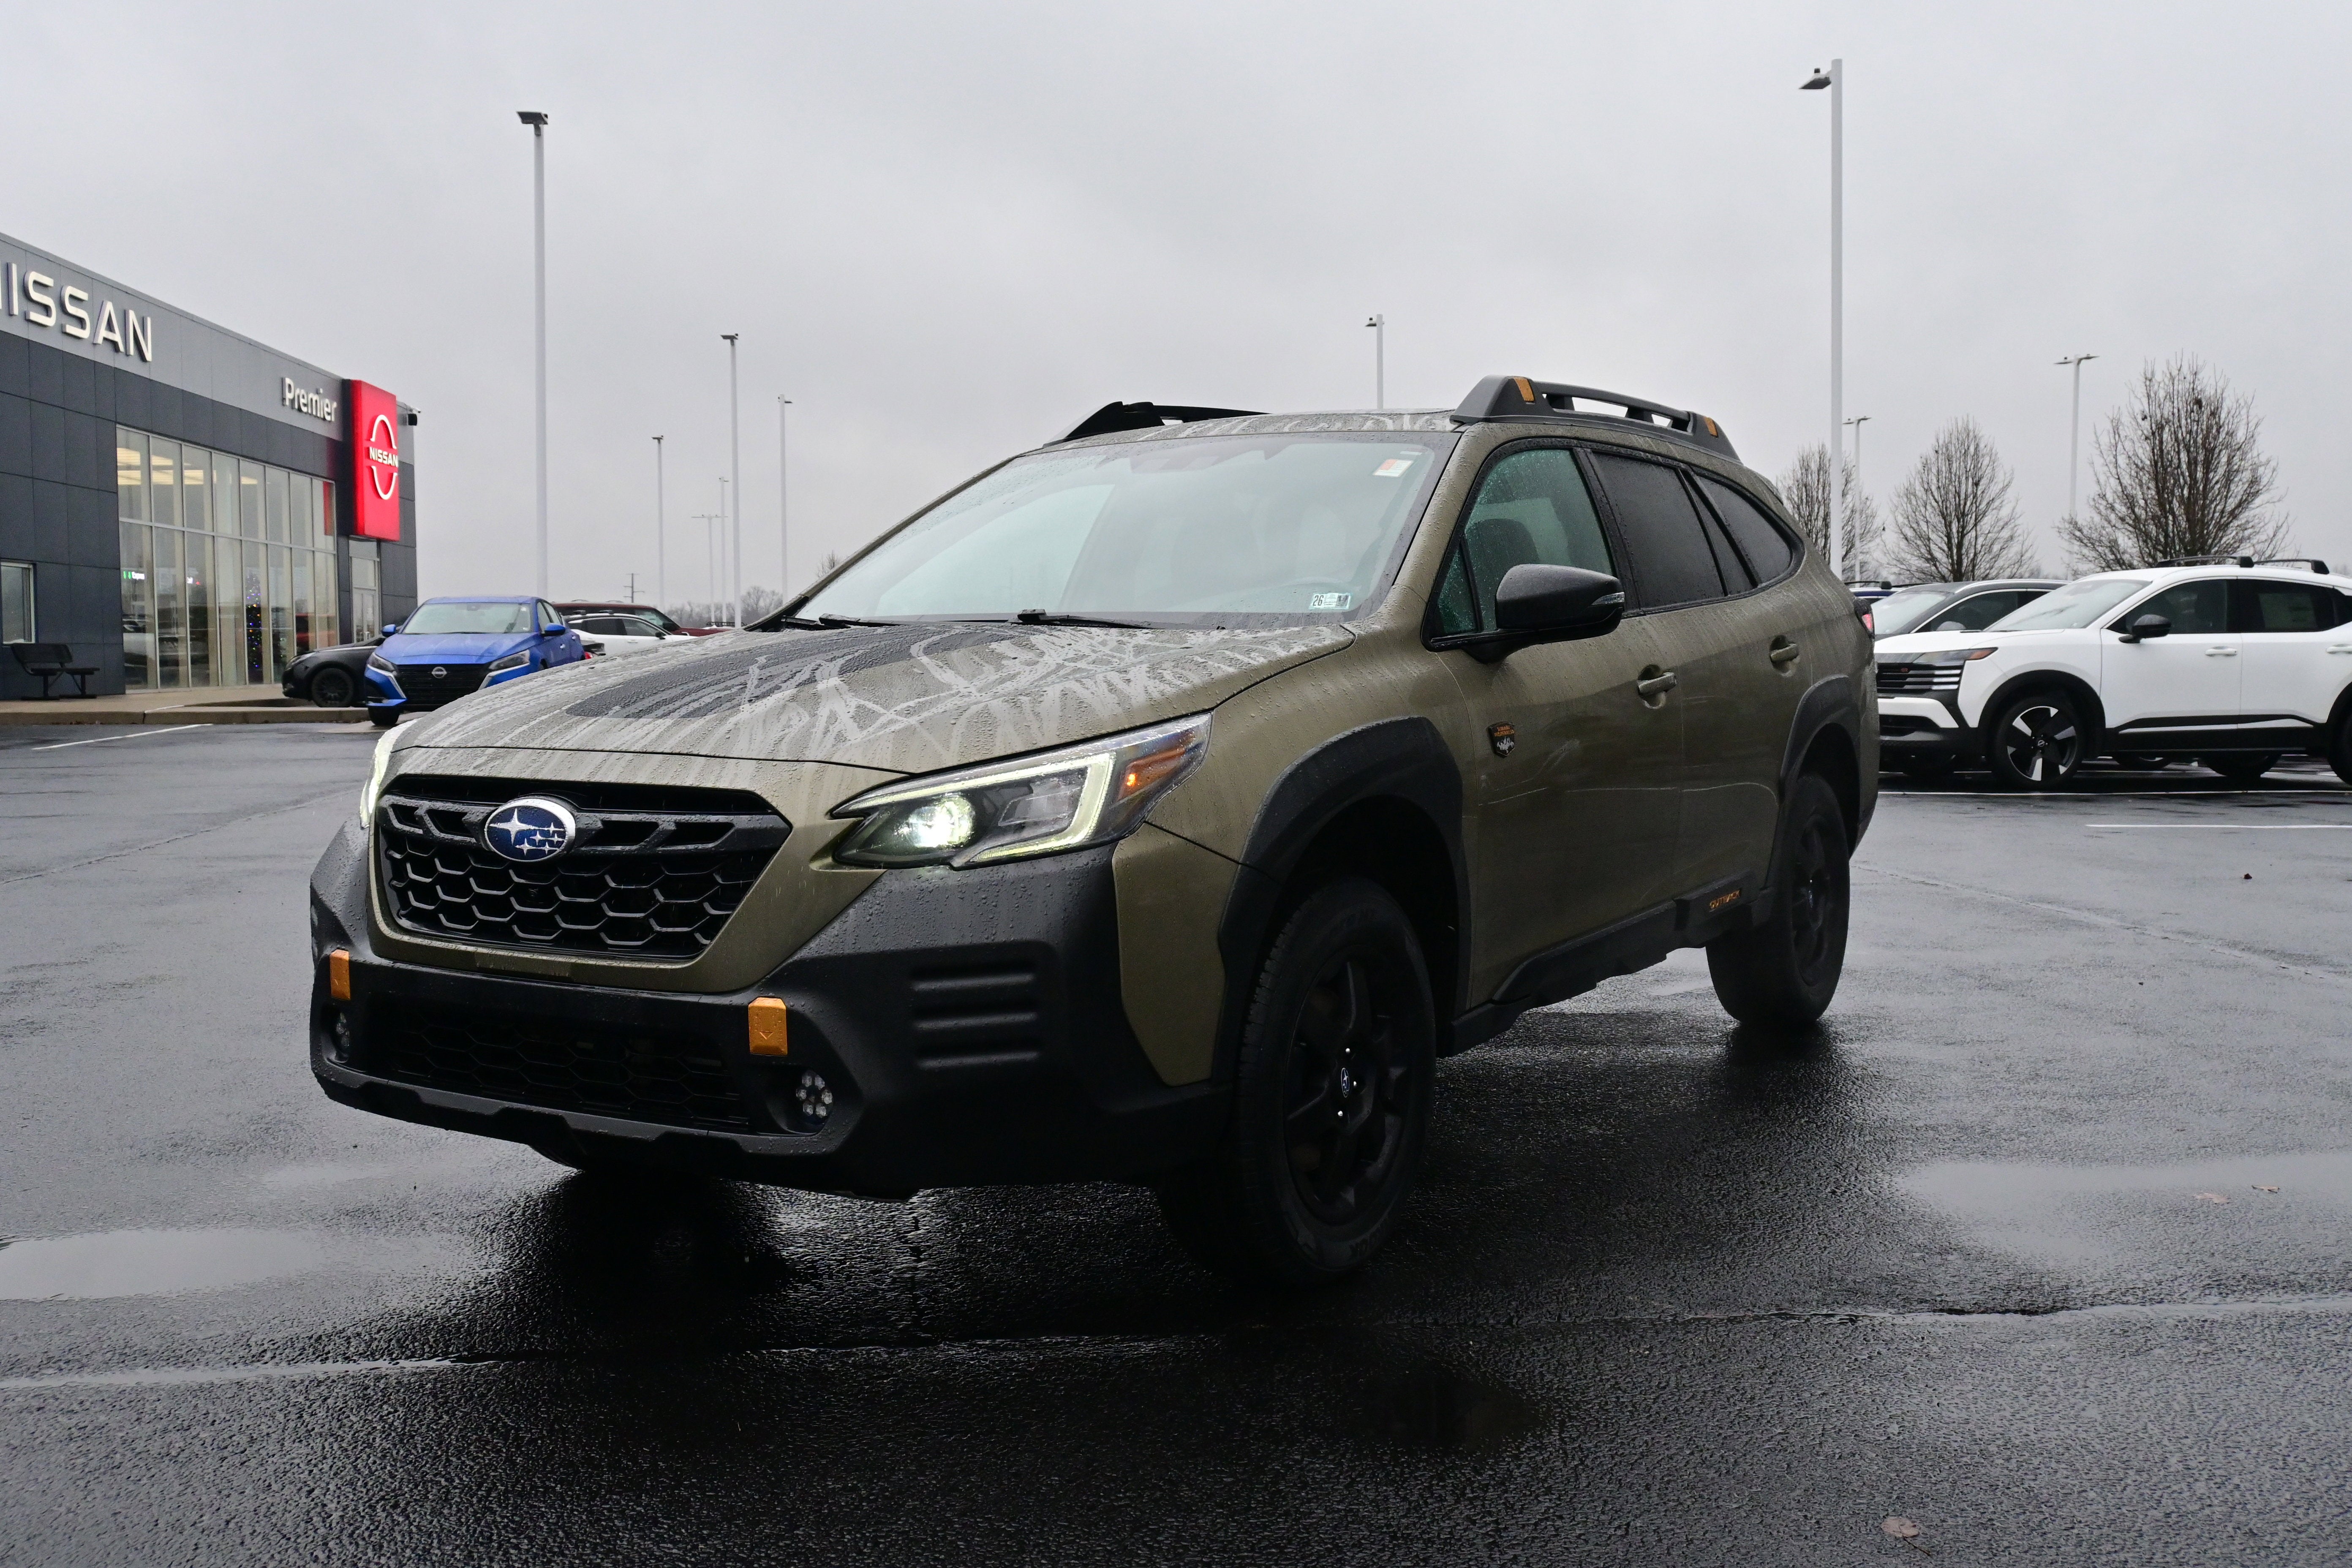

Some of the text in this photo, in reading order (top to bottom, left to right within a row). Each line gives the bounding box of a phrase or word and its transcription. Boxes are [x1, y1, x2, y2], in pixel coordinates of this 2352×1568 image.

[0, 262, 152, 362] ISSAN
[284, 377, 337, 422] Premier
[370, 446, 398, 468] NISSAN
[1312, 595, 1324, 606] 26
